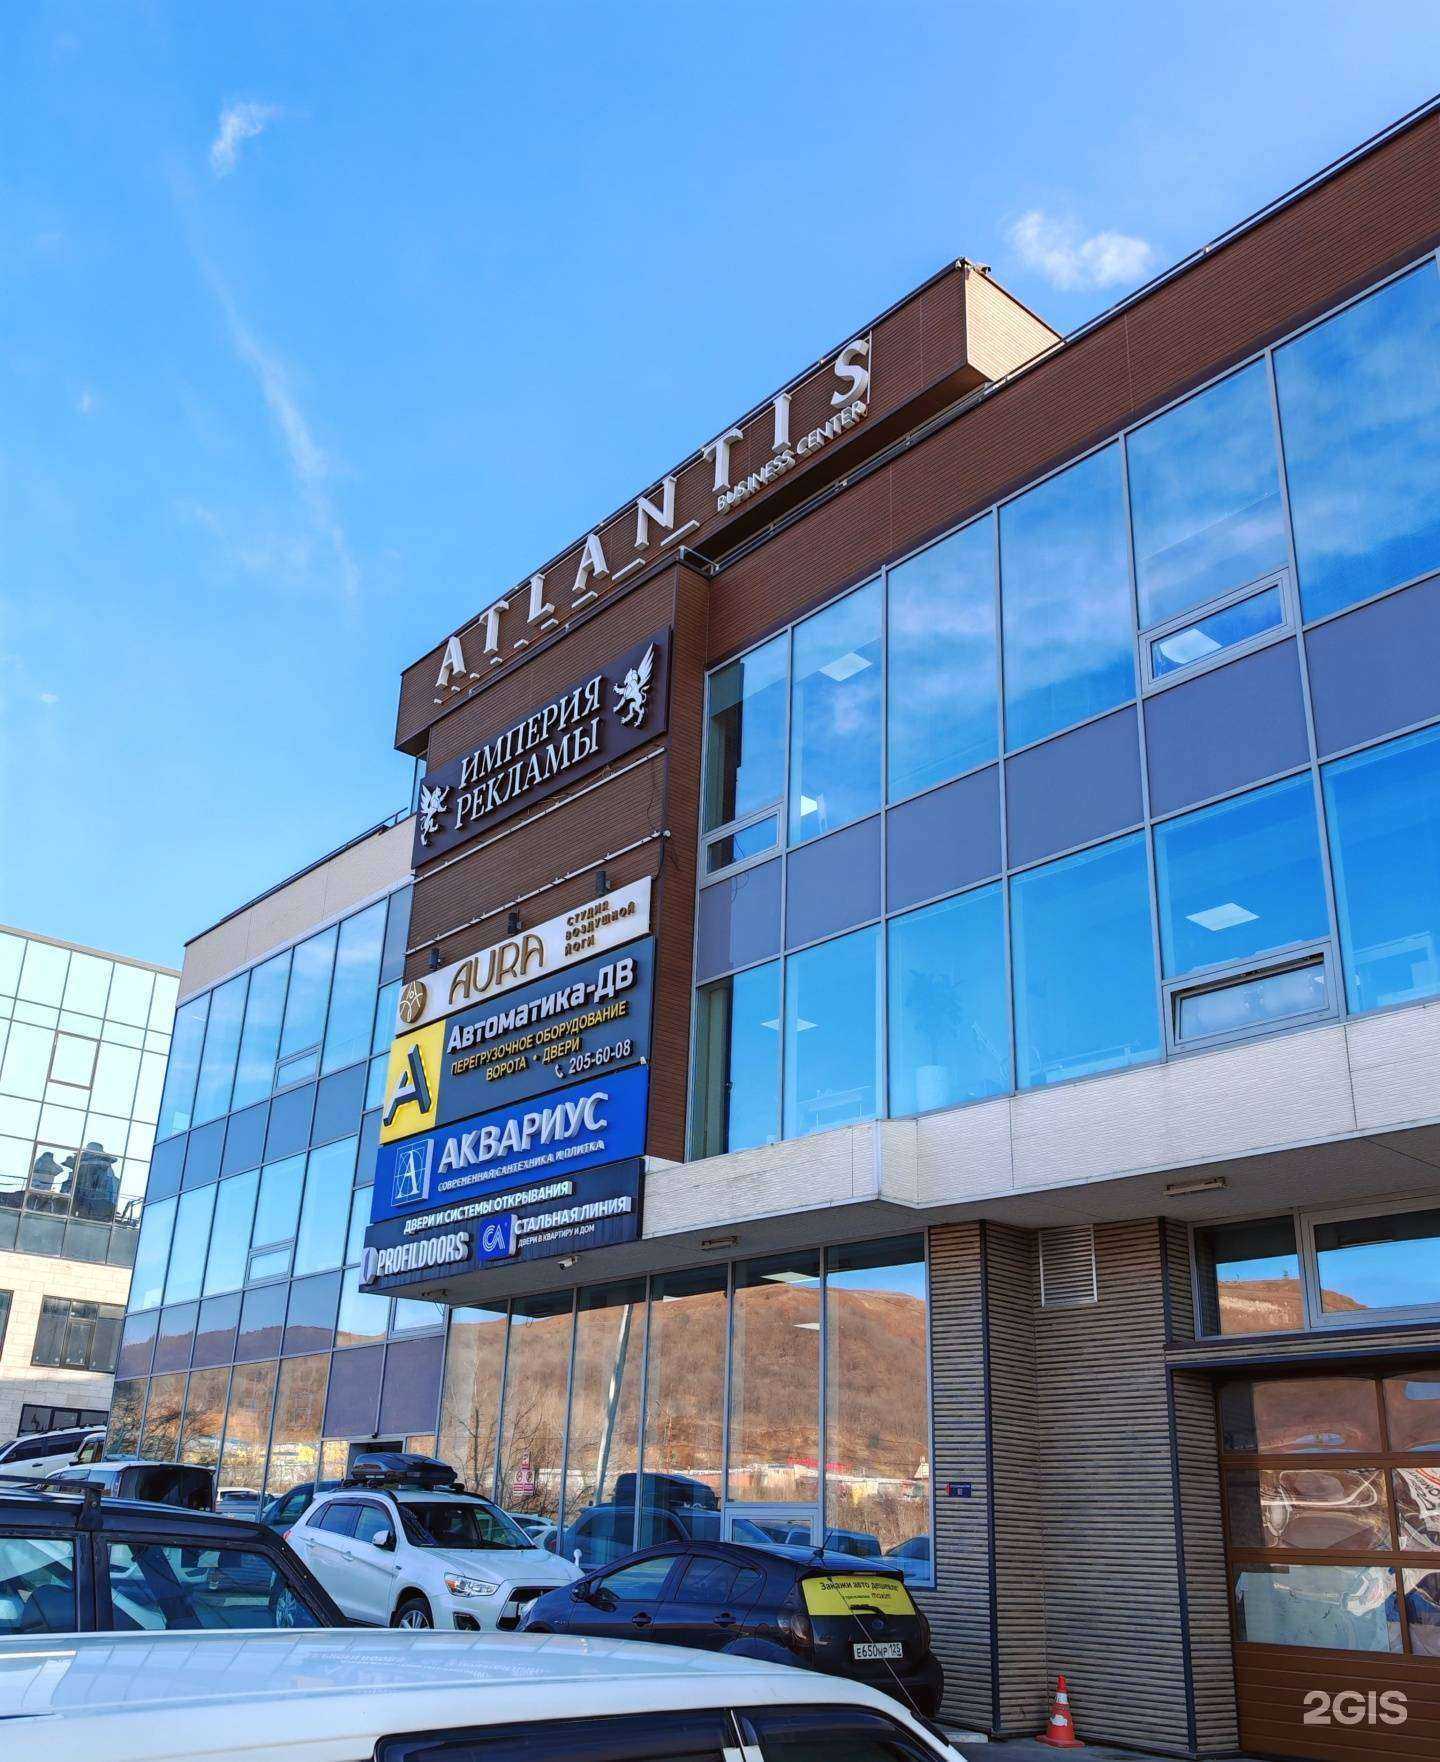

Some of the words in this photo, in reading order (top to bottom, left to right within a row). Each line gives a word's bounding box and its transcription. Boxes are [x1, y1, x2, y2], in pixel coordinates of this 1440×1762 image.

[717, 450, 796, 516] BUSINESS
[797, 400, 868, 457] CENTER
[434, 338, 869, 689] ATLANTIS
[458, 675, 602, 790] ИМПЕРИЯ
[454, 718, 601, 831] РЕКЛАМЫ
[565, 901, 636, 941] ВОЗДУШНОЙ
[567, 900, 609, 926] СТУДИЯ
[449, 934, 545, 1005] AURA
[565, 934, 595, 957] ЙОГИ
[447, 957, 636, 1054] Автоматика-ДВ
[451, 1035, 534, 1076] ПЕРЕГРУЗОЧНОЕ
[536, 1000, 628, 1045] ОБОРУДОВАНИЕ
[486, 1056, 527, 1081] ВОРОТА
[542, 1037, 581, 1064] ДВЕРИ
[569, 1039, 632, 1075] 205-60-08
[438, 1092, 609, 1174] АКВАРИУС
[437, 1169, 495, 1192] СОВРЕМЕННАЯ
[496, 1154, 555, 1177] САНТЕХНИКА
[564, 1140, 605, 1159] ПЛИТКА
[404, 1214, 436, 1234] ДВЕРИ
[436, 1211, 443, 1224] И
[443, 1201, 494, 1225] СИСТЕМЫ
[494, 1181, 573, 1211] ОТКРЫВАНИЯ
[514, 1207, 582, 1235] СТАЛЬНАЯ
[580, 1196, 632, 1220] ЛИНИЯ
[377, 1231, 470, 1277] PROFILDOORS
[518, 1236, 538, 1248] ДВЕРИ
[543, 1228, 574, 1242] КВАРТИРУ
[580, 1224, 595, 1235] ДОМ
